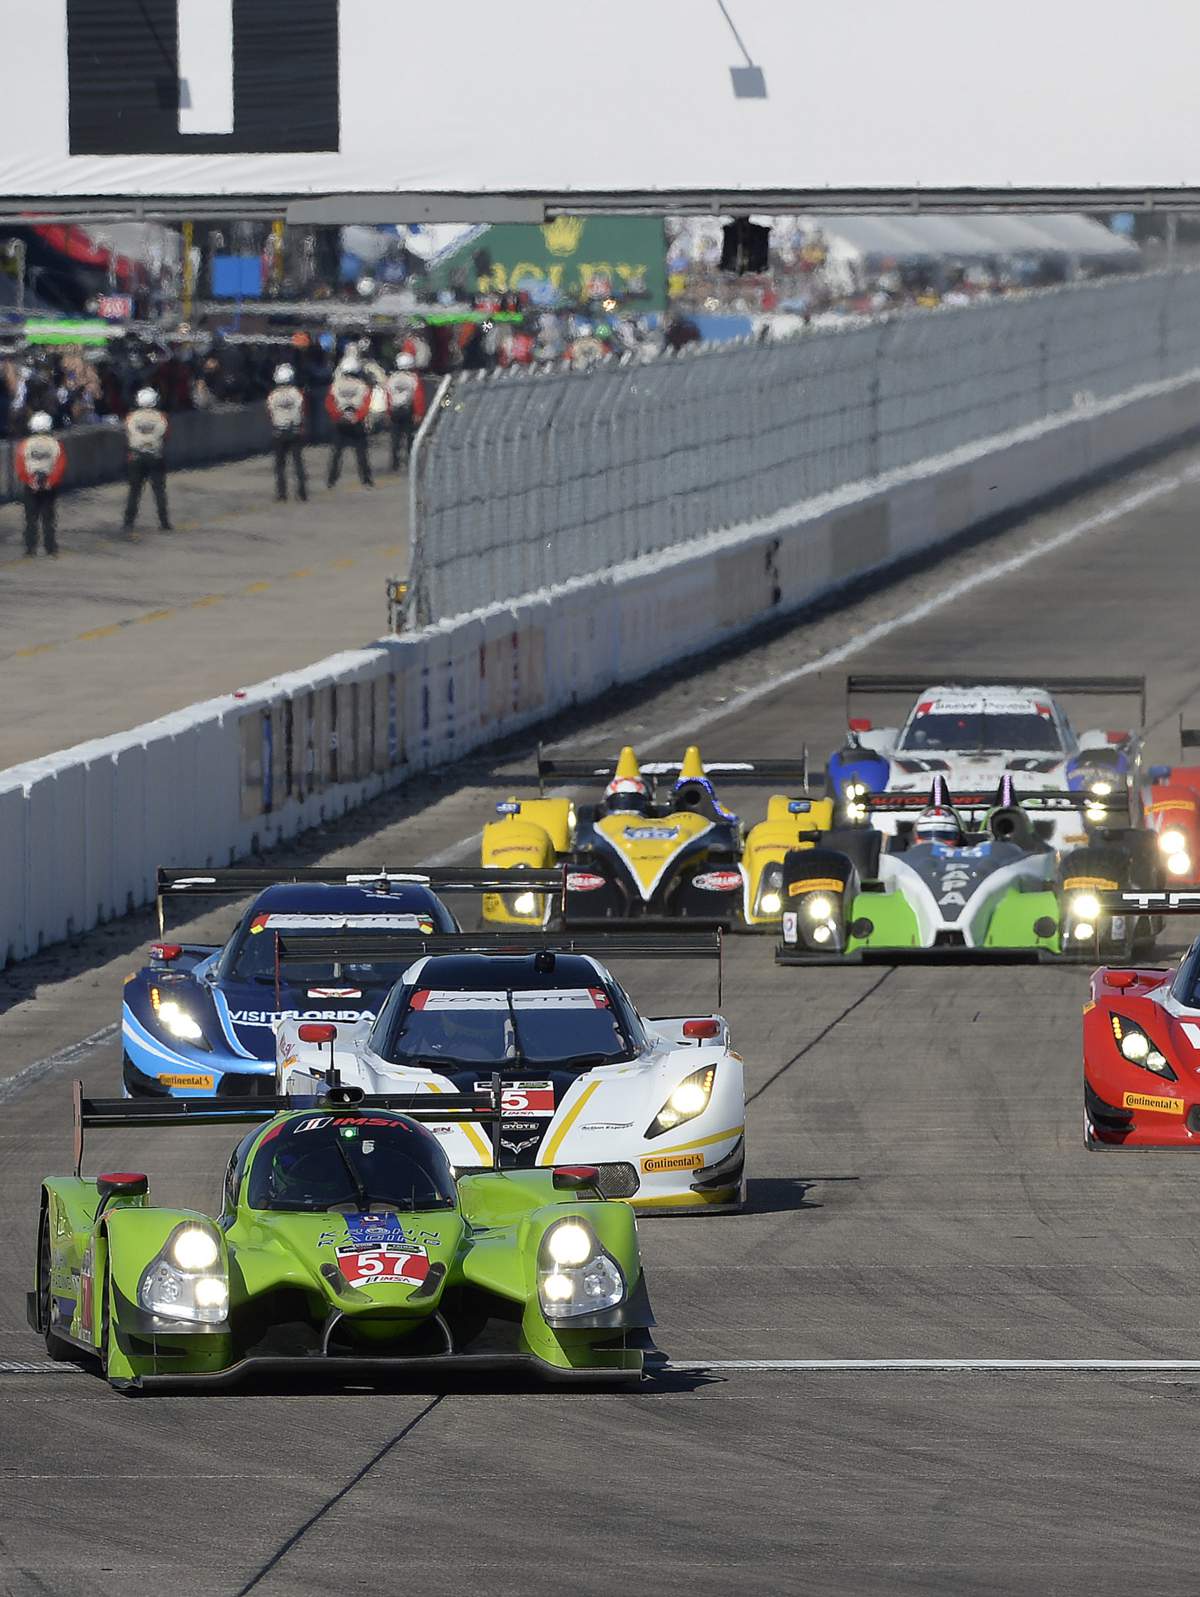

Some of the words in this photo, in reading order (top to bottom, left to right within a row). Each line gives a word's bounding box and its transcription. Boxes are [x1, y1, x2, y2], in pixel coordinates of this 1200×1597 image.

[501, 1090, 529, 1111] 5
[1126, 1095, 1172, 1109] Continental
[332, 1117, 409, 1132] IMSA
[644, 1156, 694, 1173] Continental
[357, 1253, 412, 1276] 57
